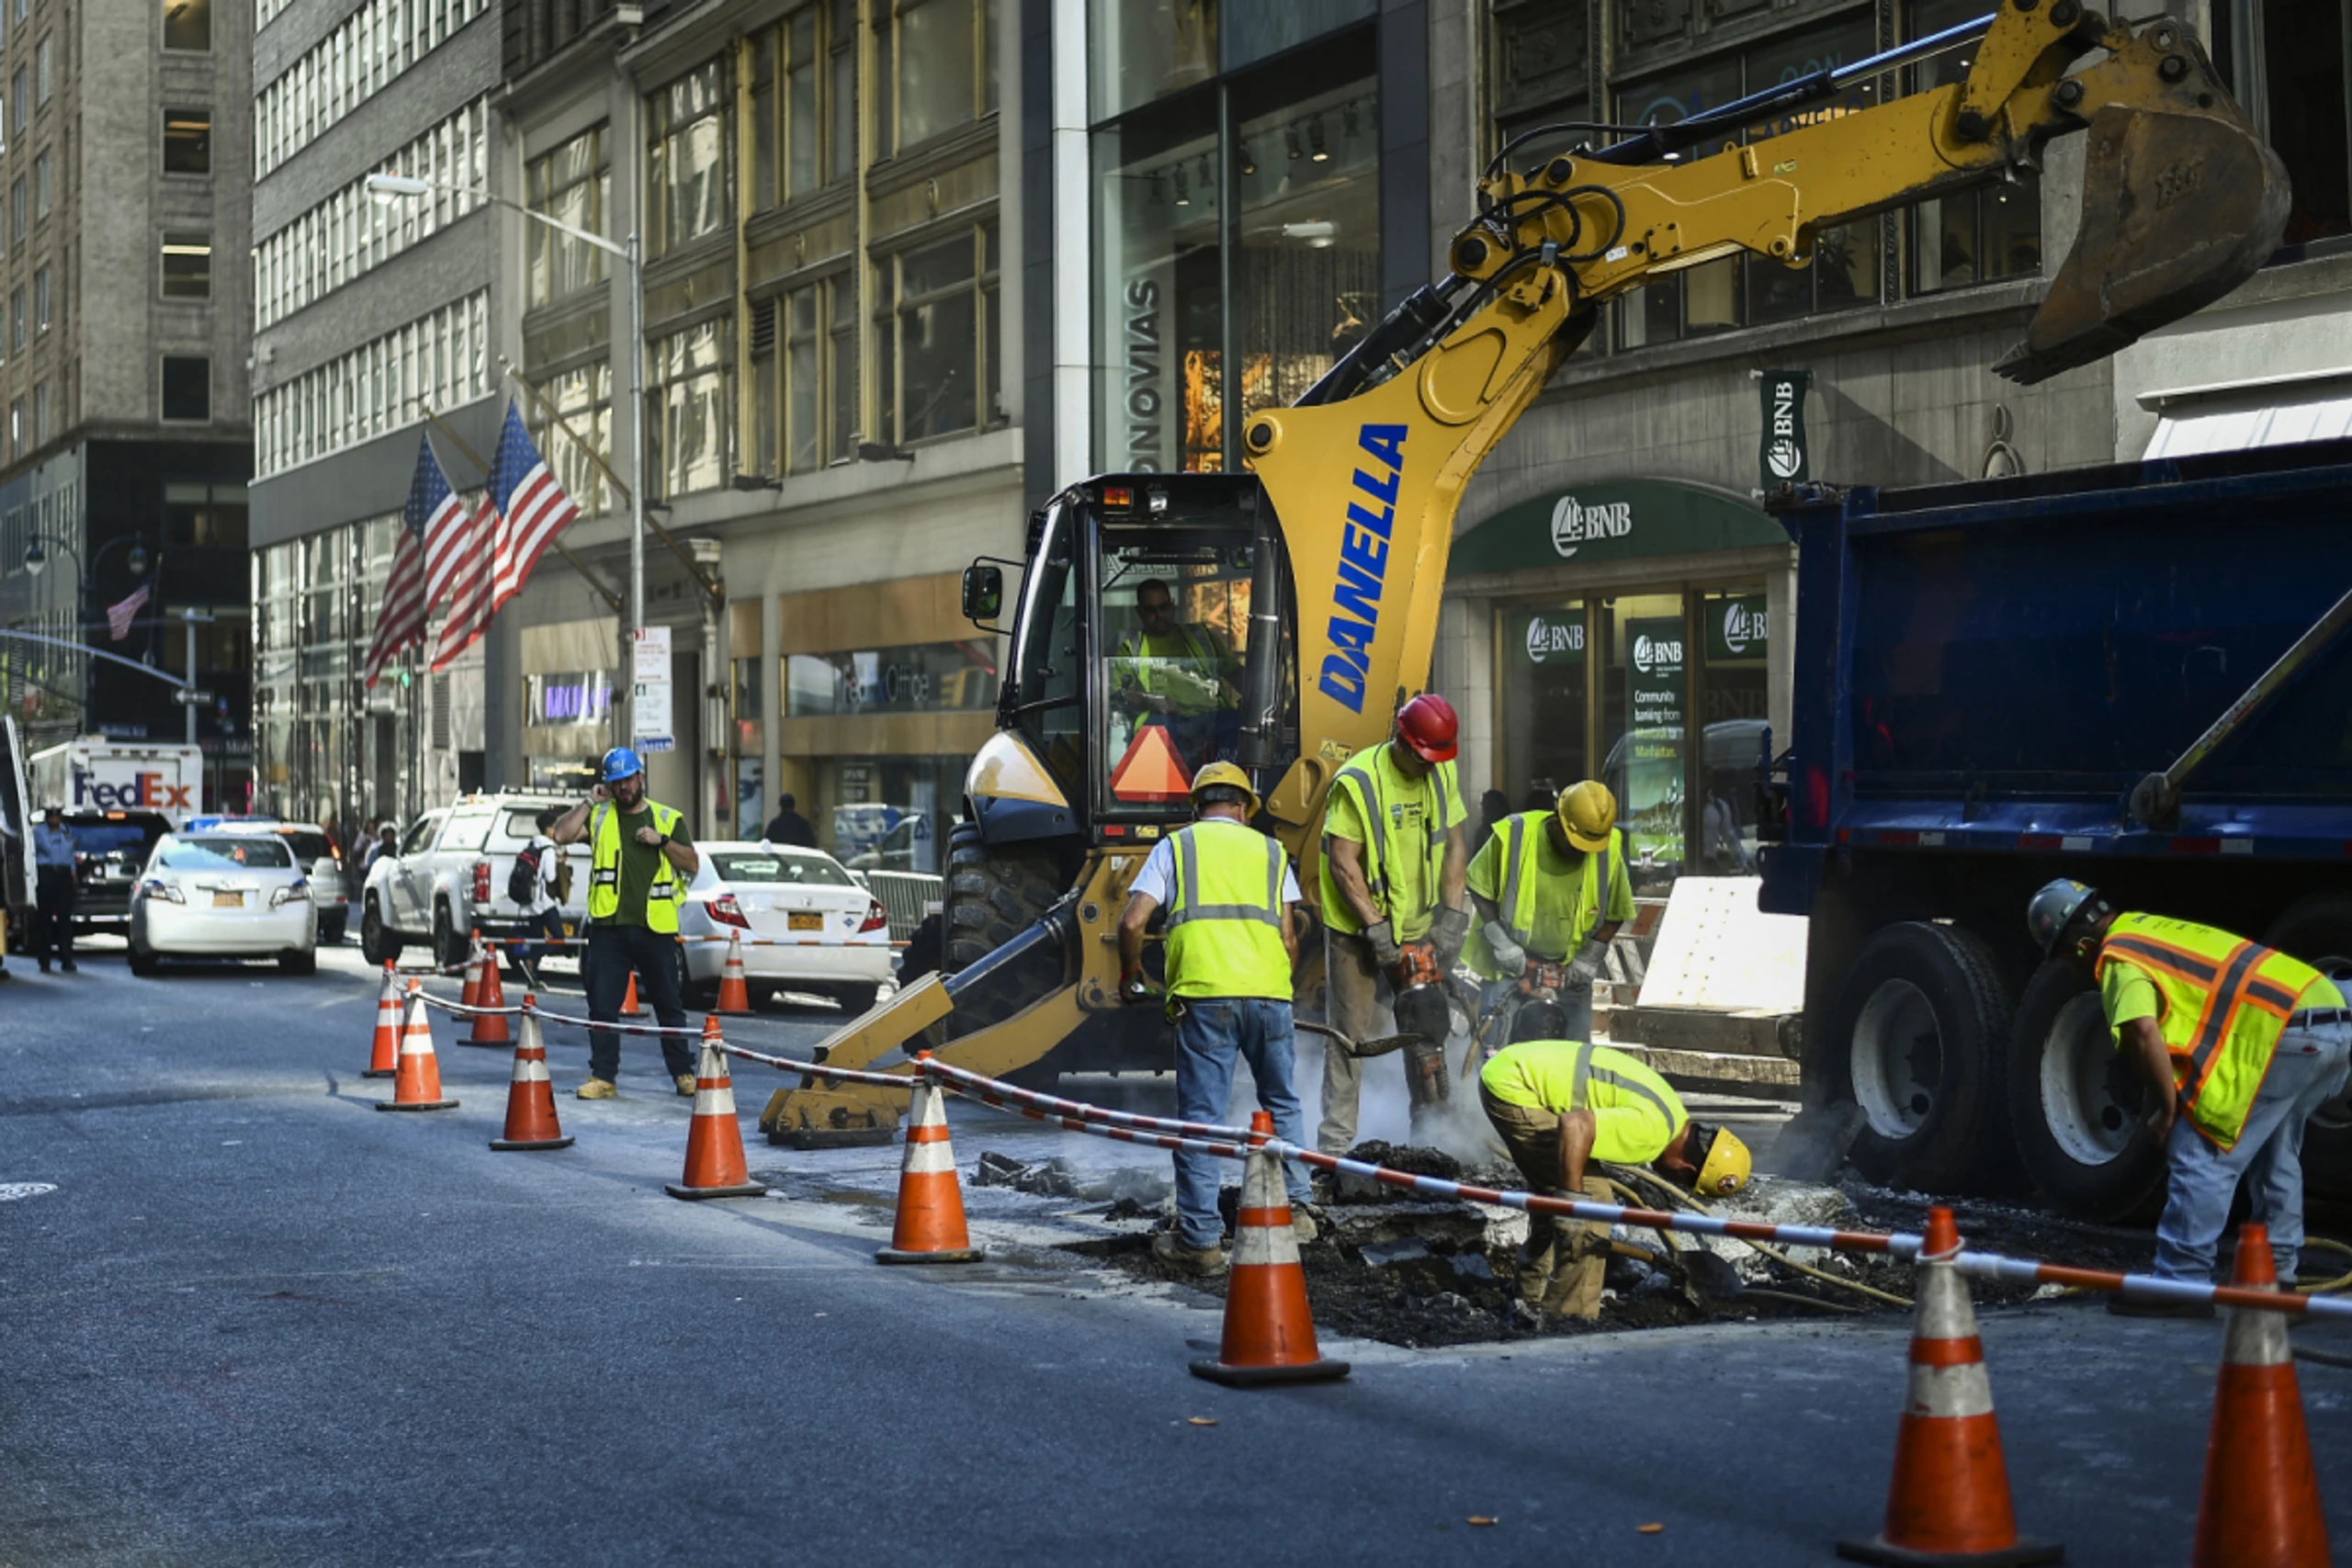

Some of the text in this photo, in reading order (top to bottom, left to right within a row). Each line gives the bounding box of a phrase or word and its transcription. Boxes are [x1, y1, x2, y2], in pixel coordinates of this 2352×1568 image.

[1773, 381, 1793, 436] BNB
[1584, 502, 1632, 540] BNB
[1317, 423, 1408, 715] DANELLA
[1551, 625, 1585, 651] BNB
[1655, 641, 1683, 664] BNB
[74, 771, 192, 809] FedEx
